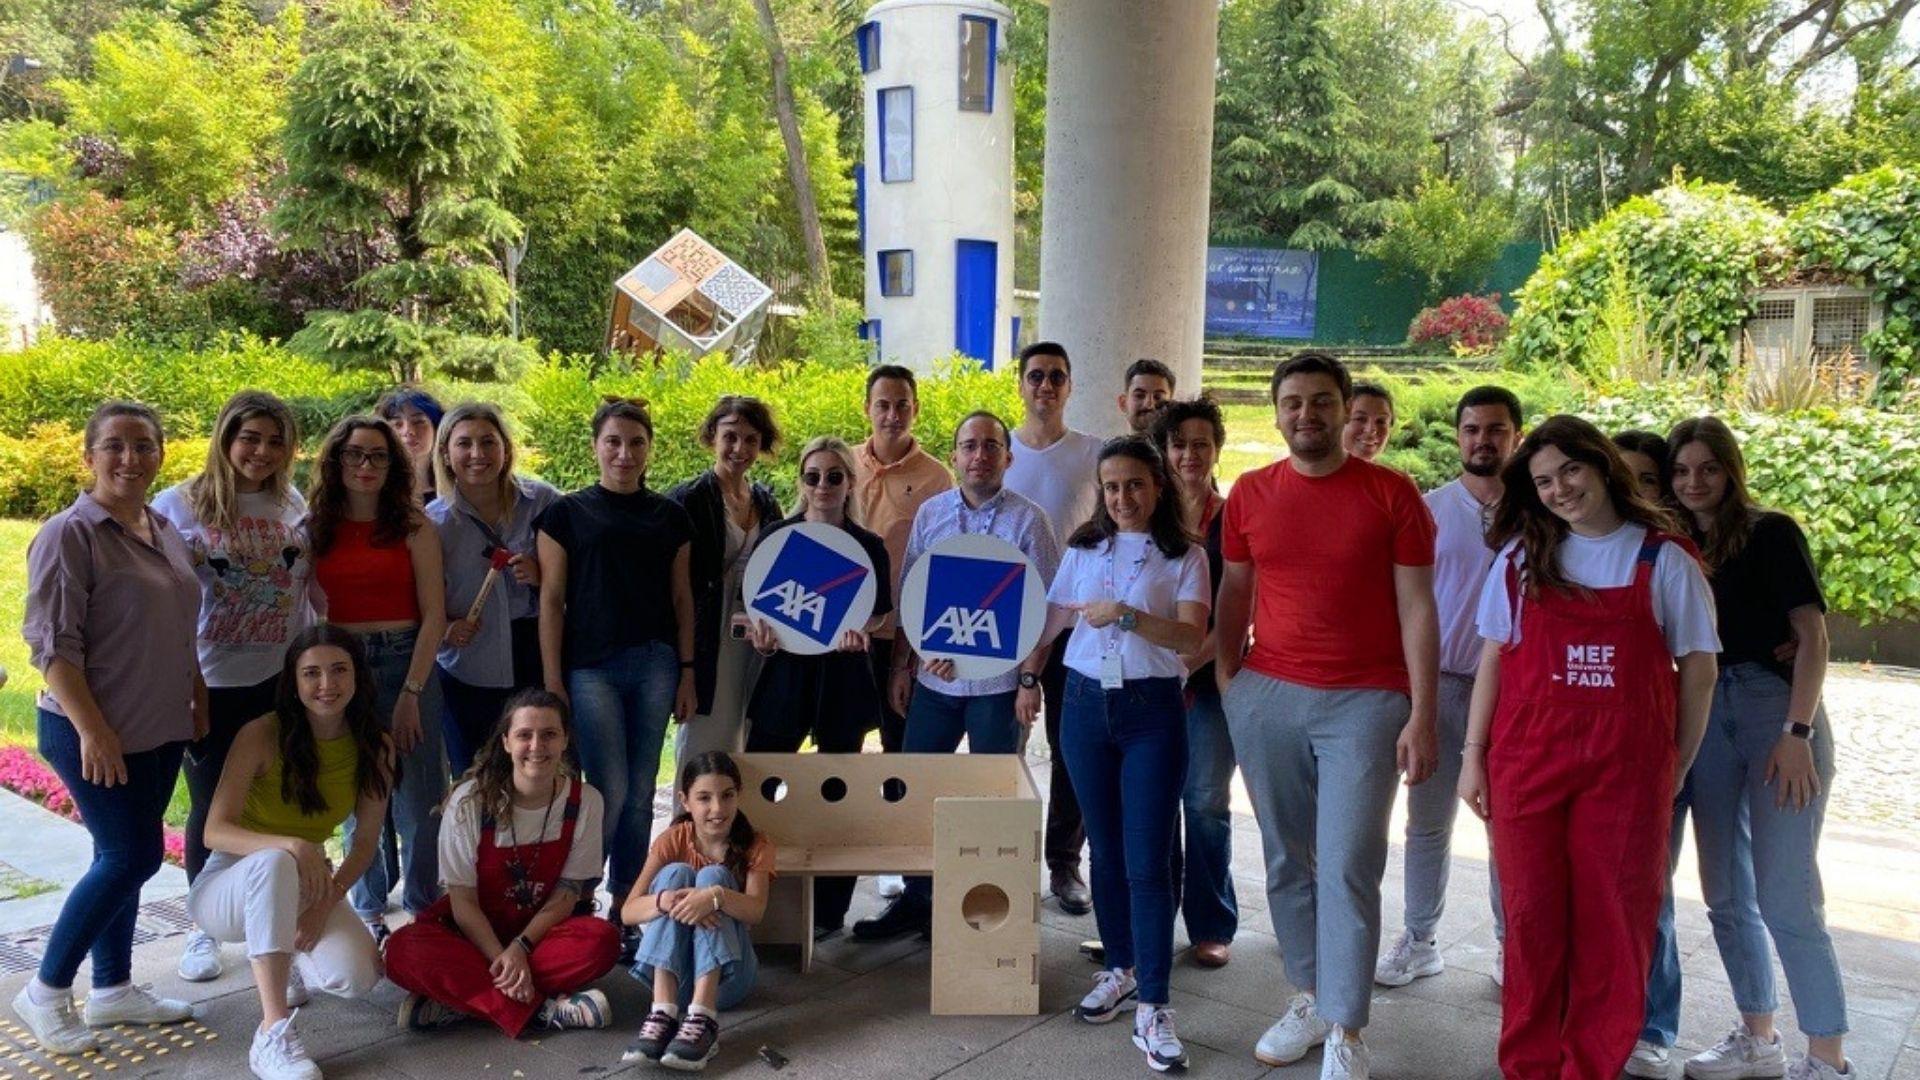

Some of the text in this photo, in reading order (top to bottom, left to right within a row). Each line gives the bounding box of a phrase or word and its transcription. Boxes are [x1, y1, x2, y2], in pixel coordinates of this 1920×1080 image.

[754, 579, 827, 632] AXA
[922, 607, 1002, 649] AXA
[1567, 645, 1615, 663] MEF
[1567, 662, 1615, 673] University
[1567, 671, 1615, 687] FADA
